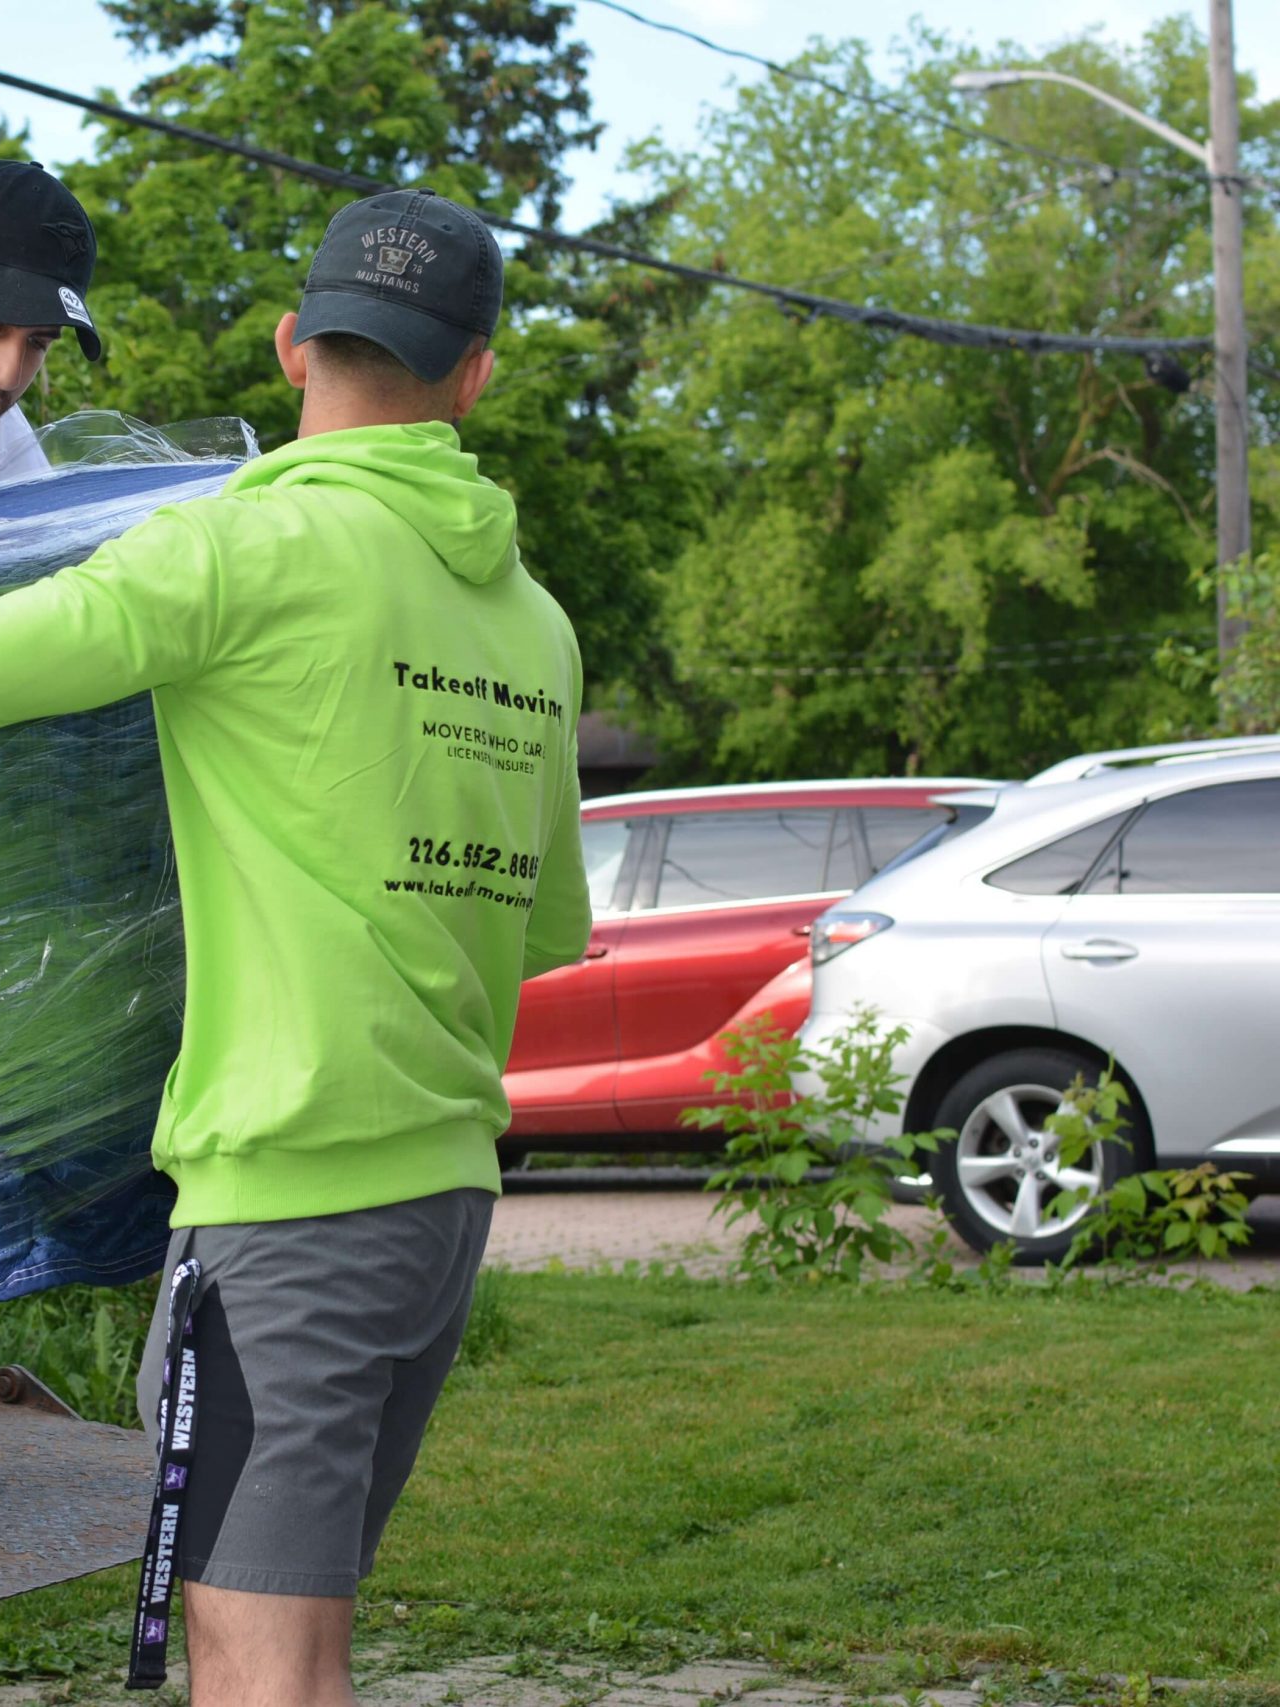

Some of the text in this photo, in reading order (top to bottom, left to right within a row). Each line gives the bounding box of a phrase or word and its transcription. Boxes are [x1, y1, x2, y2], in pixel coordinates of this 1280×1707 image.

[361, 227, 438, 264] WESTERN
[363, 253, 374, 263] 18
[355, 270, 420, 294] MUSTANGS
[394, 662, 488, 701] Takeoff
[422, 720, 487, 746] MOVERS
[488, 734, 519, 754] WHO
[171, 1346, 196, 1450] WESTERN
[150, 1503, 180, 1604] WESTERN
